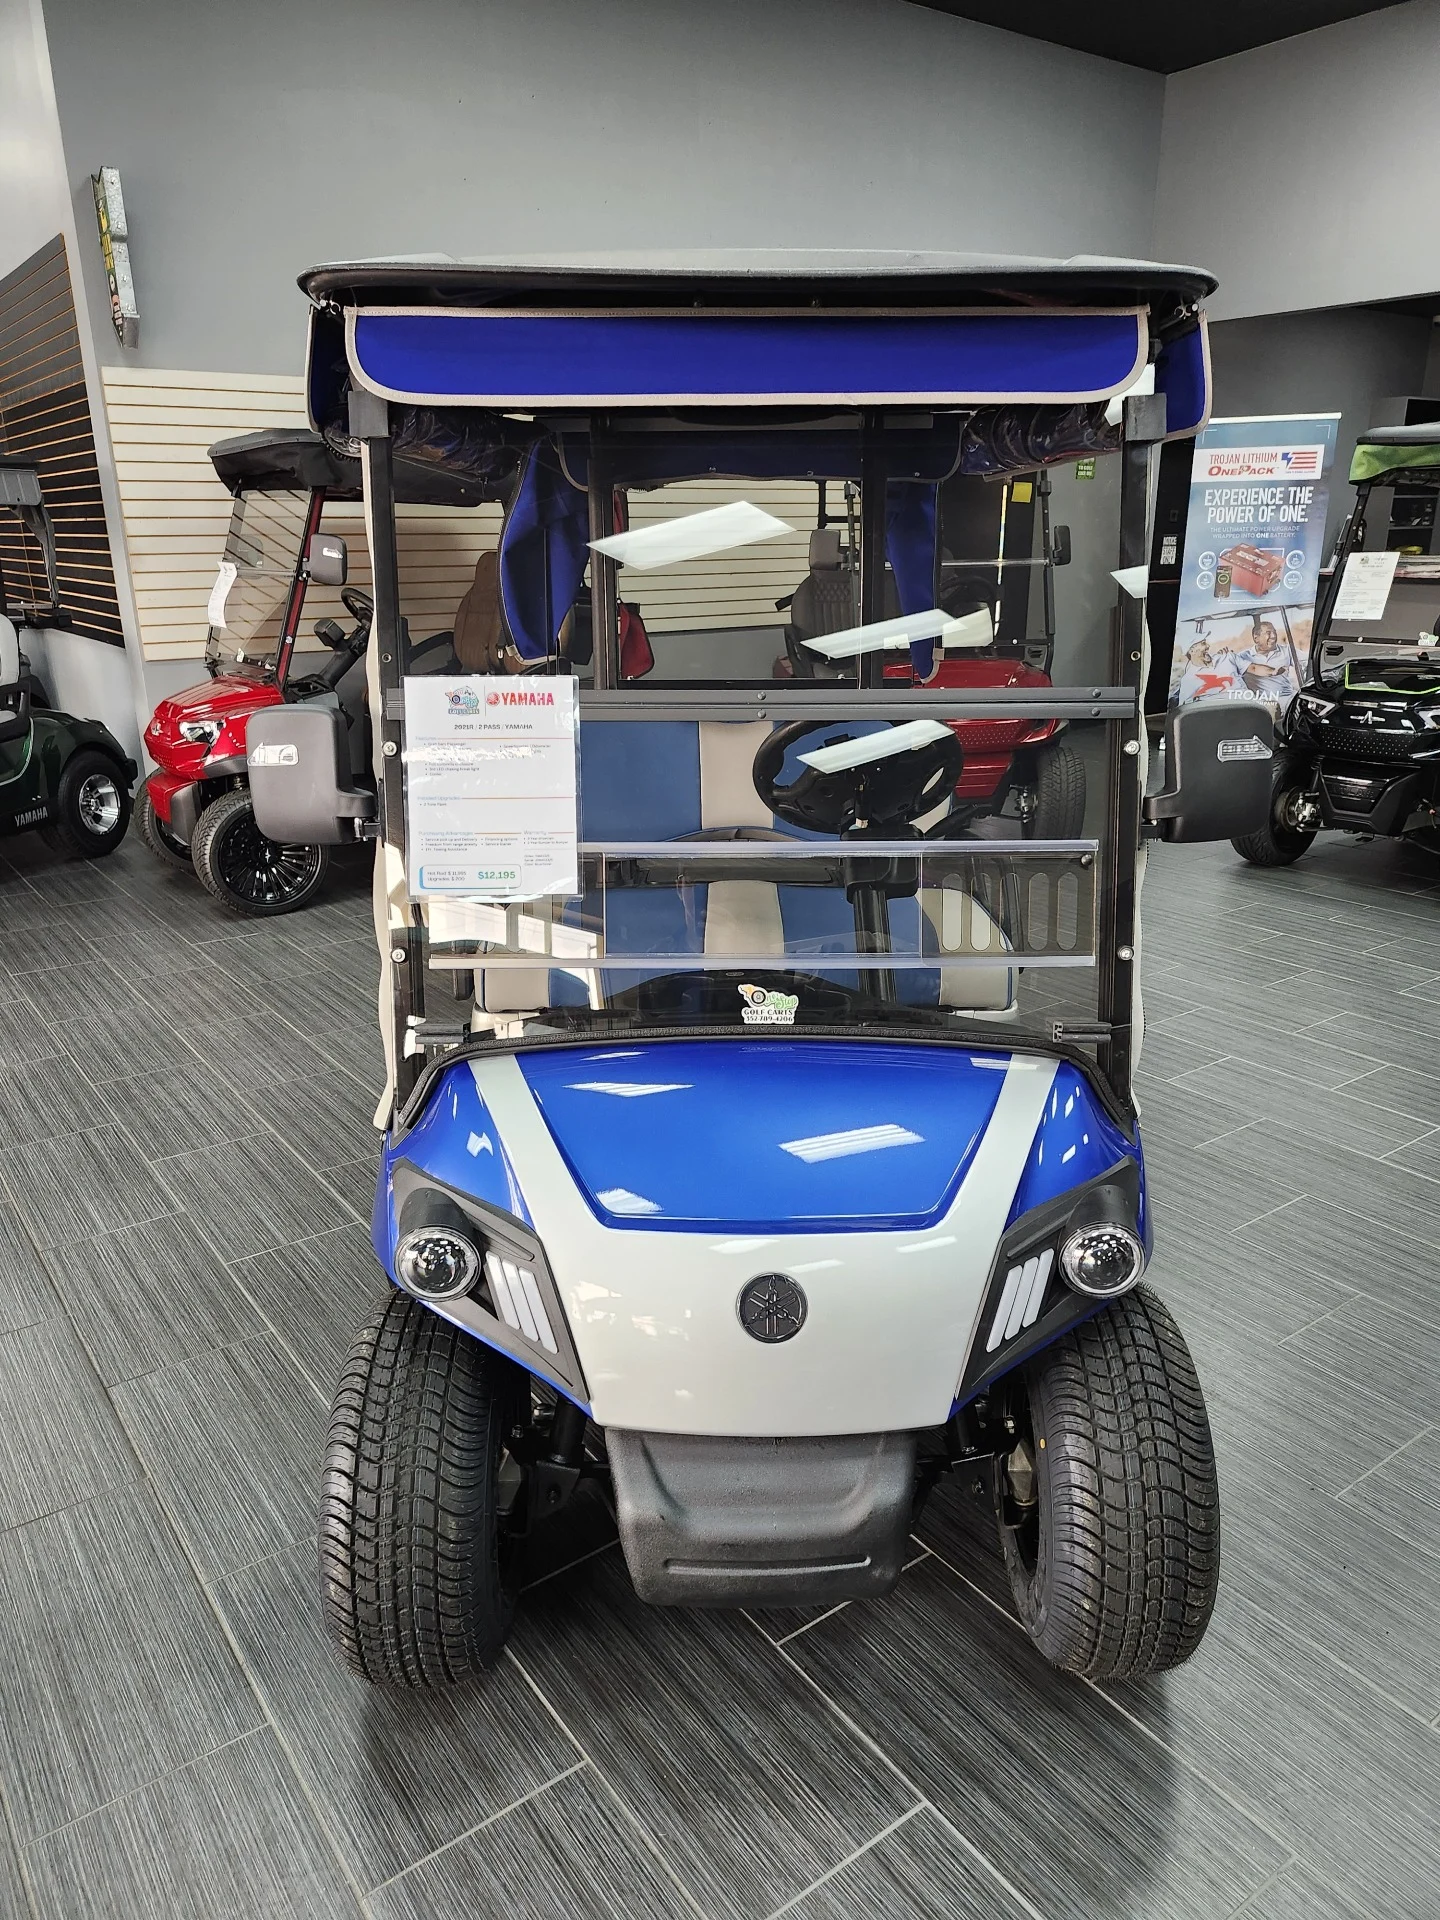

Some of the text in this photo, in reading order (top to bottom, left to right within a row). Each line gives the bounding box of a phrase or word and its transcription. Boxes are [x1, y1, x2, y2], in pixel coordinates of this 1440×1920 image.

[1209, 452, 1278, 465] TROJAN LITHIUM
[1204, 486, 1314, 506] EXPERIENCE THE
[1207, 505, 1309, 524] POWER OF ONE.
[501, 692, 555, 706] YAMAHA
[1226, 689, 1280, 701] TROJAN
[14, 806, 48, 827] YAMAHA
[477, 871, 516, 880] $12,195
